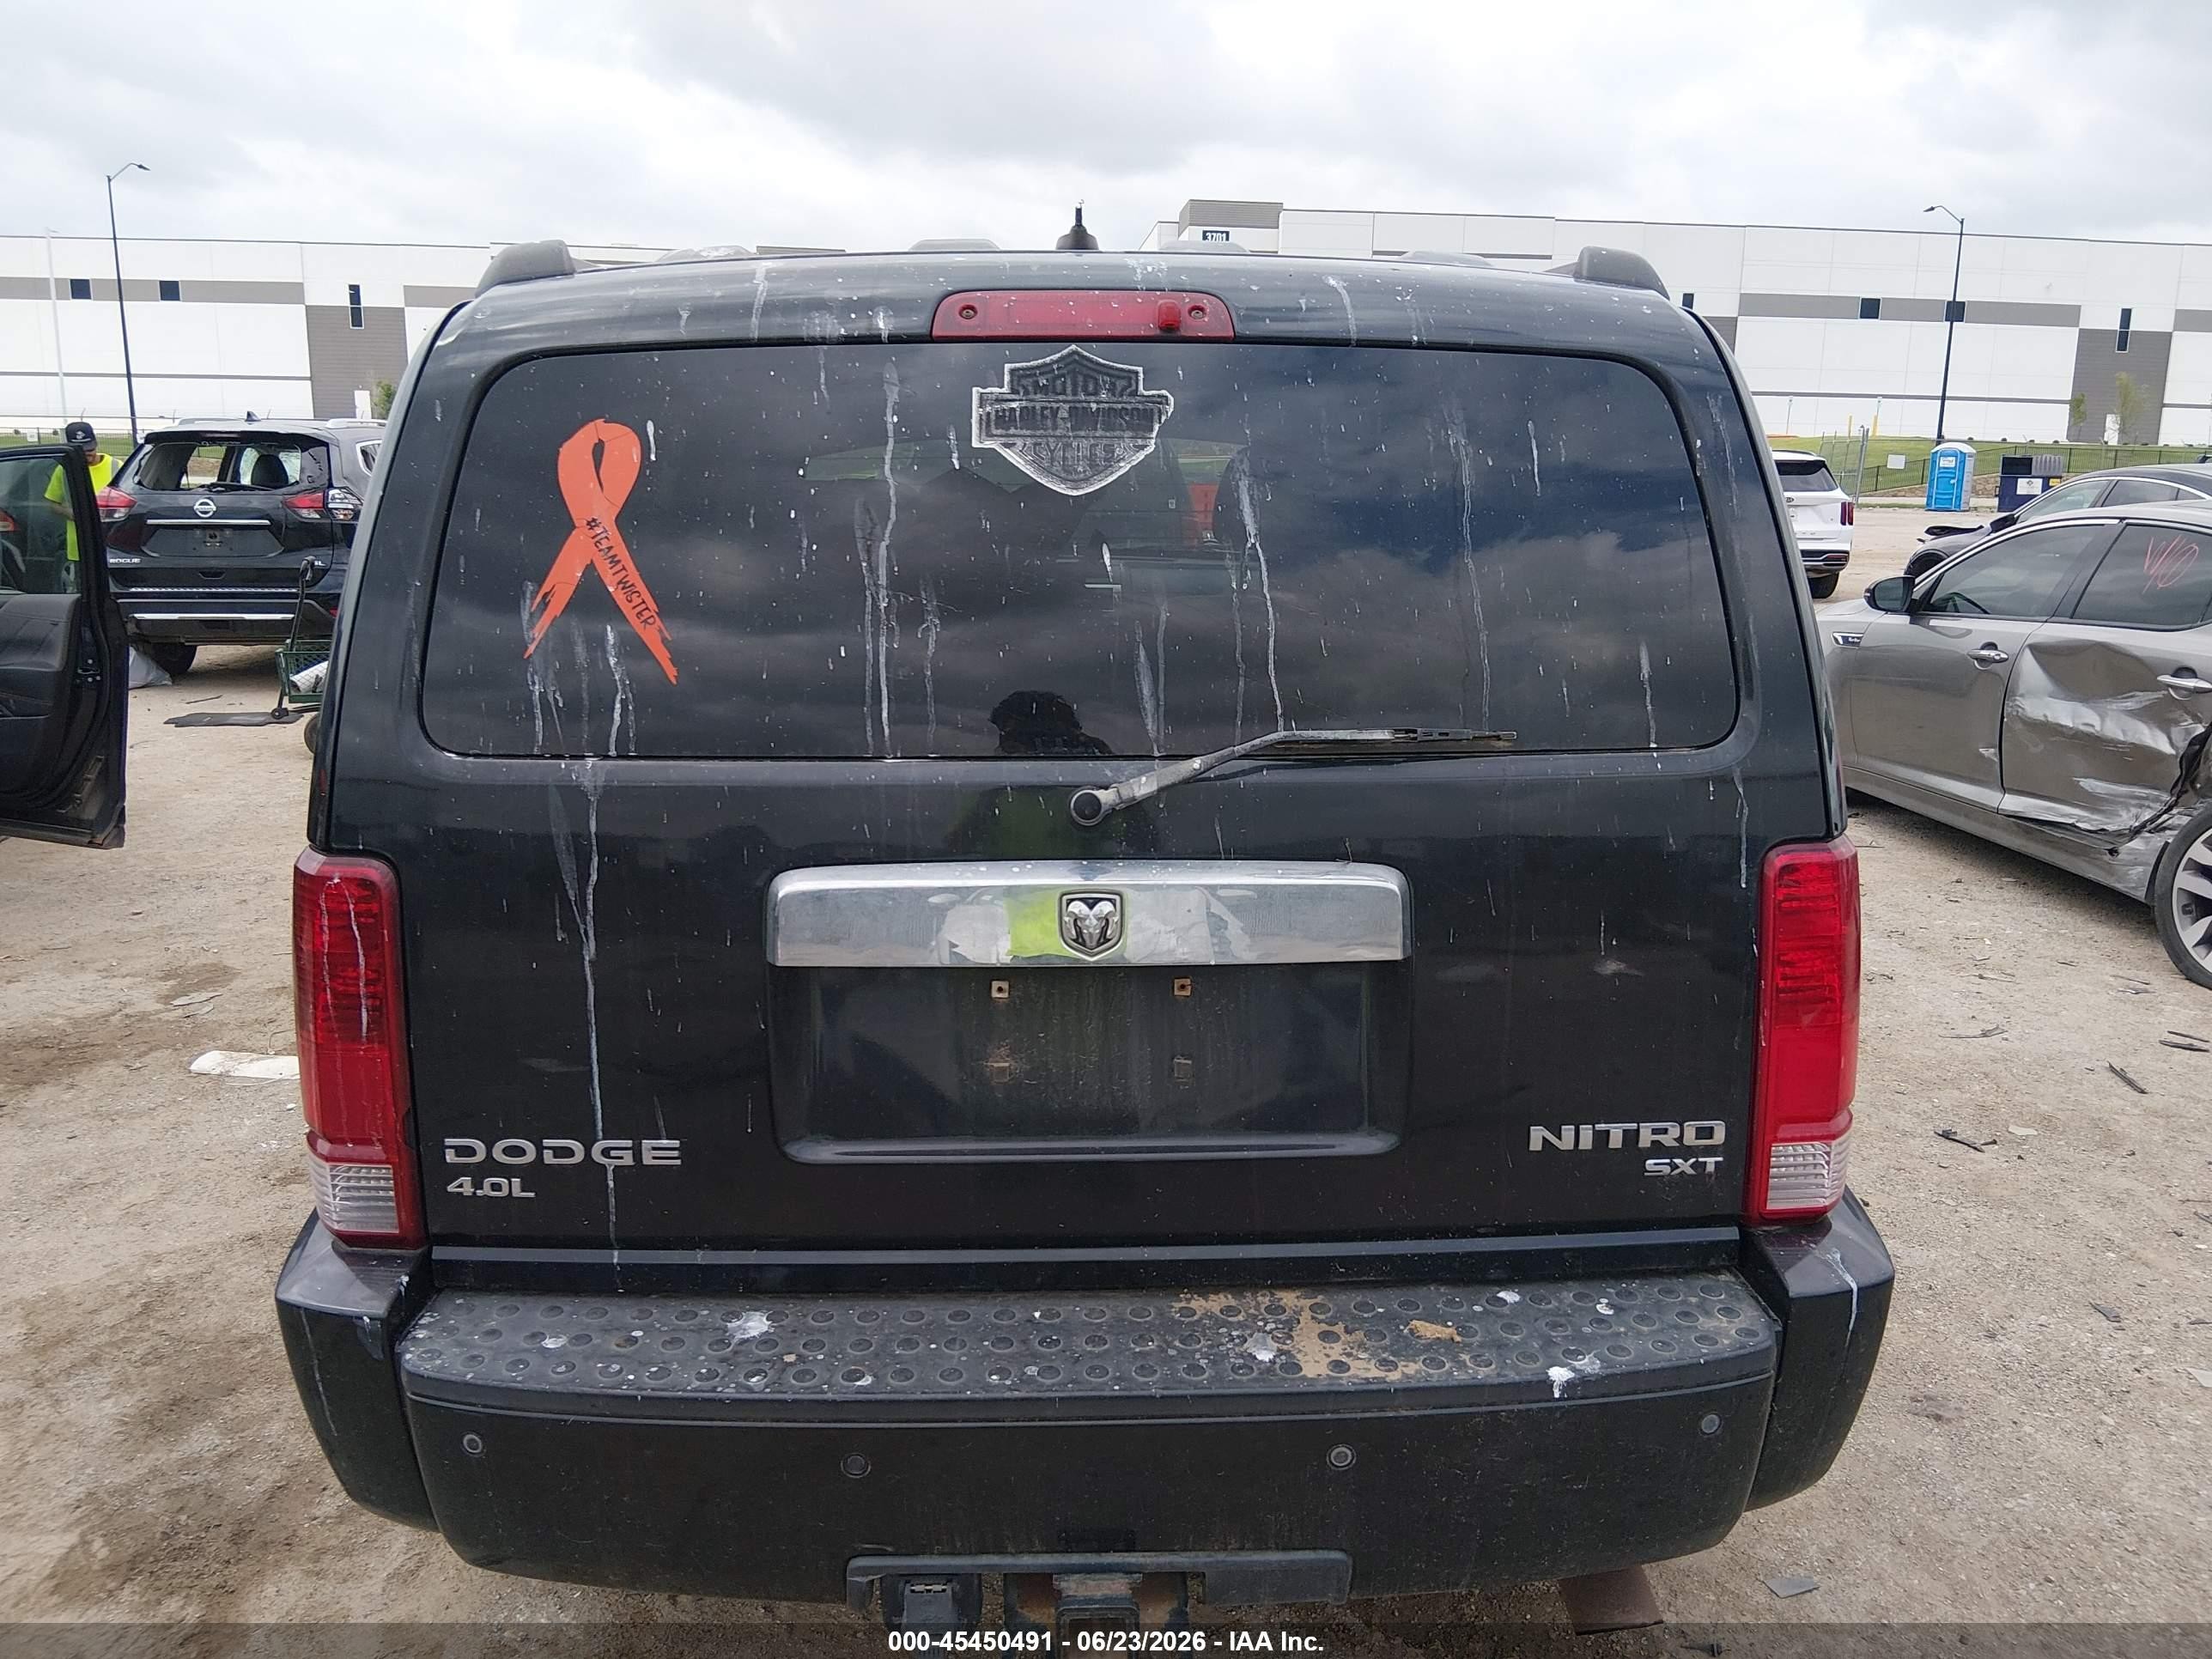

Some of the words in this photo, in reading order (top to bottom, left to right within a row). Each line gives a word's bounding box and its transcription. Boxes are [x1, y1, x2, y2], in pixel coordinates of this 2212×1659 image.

[1528, 1120, 1726, 1152] NITRO
[444, 1138, 682, 1166] DODGE
[1644, 1157, 1724, 1176] SXT
[447, 1176, 536, 1198] 4.0L
